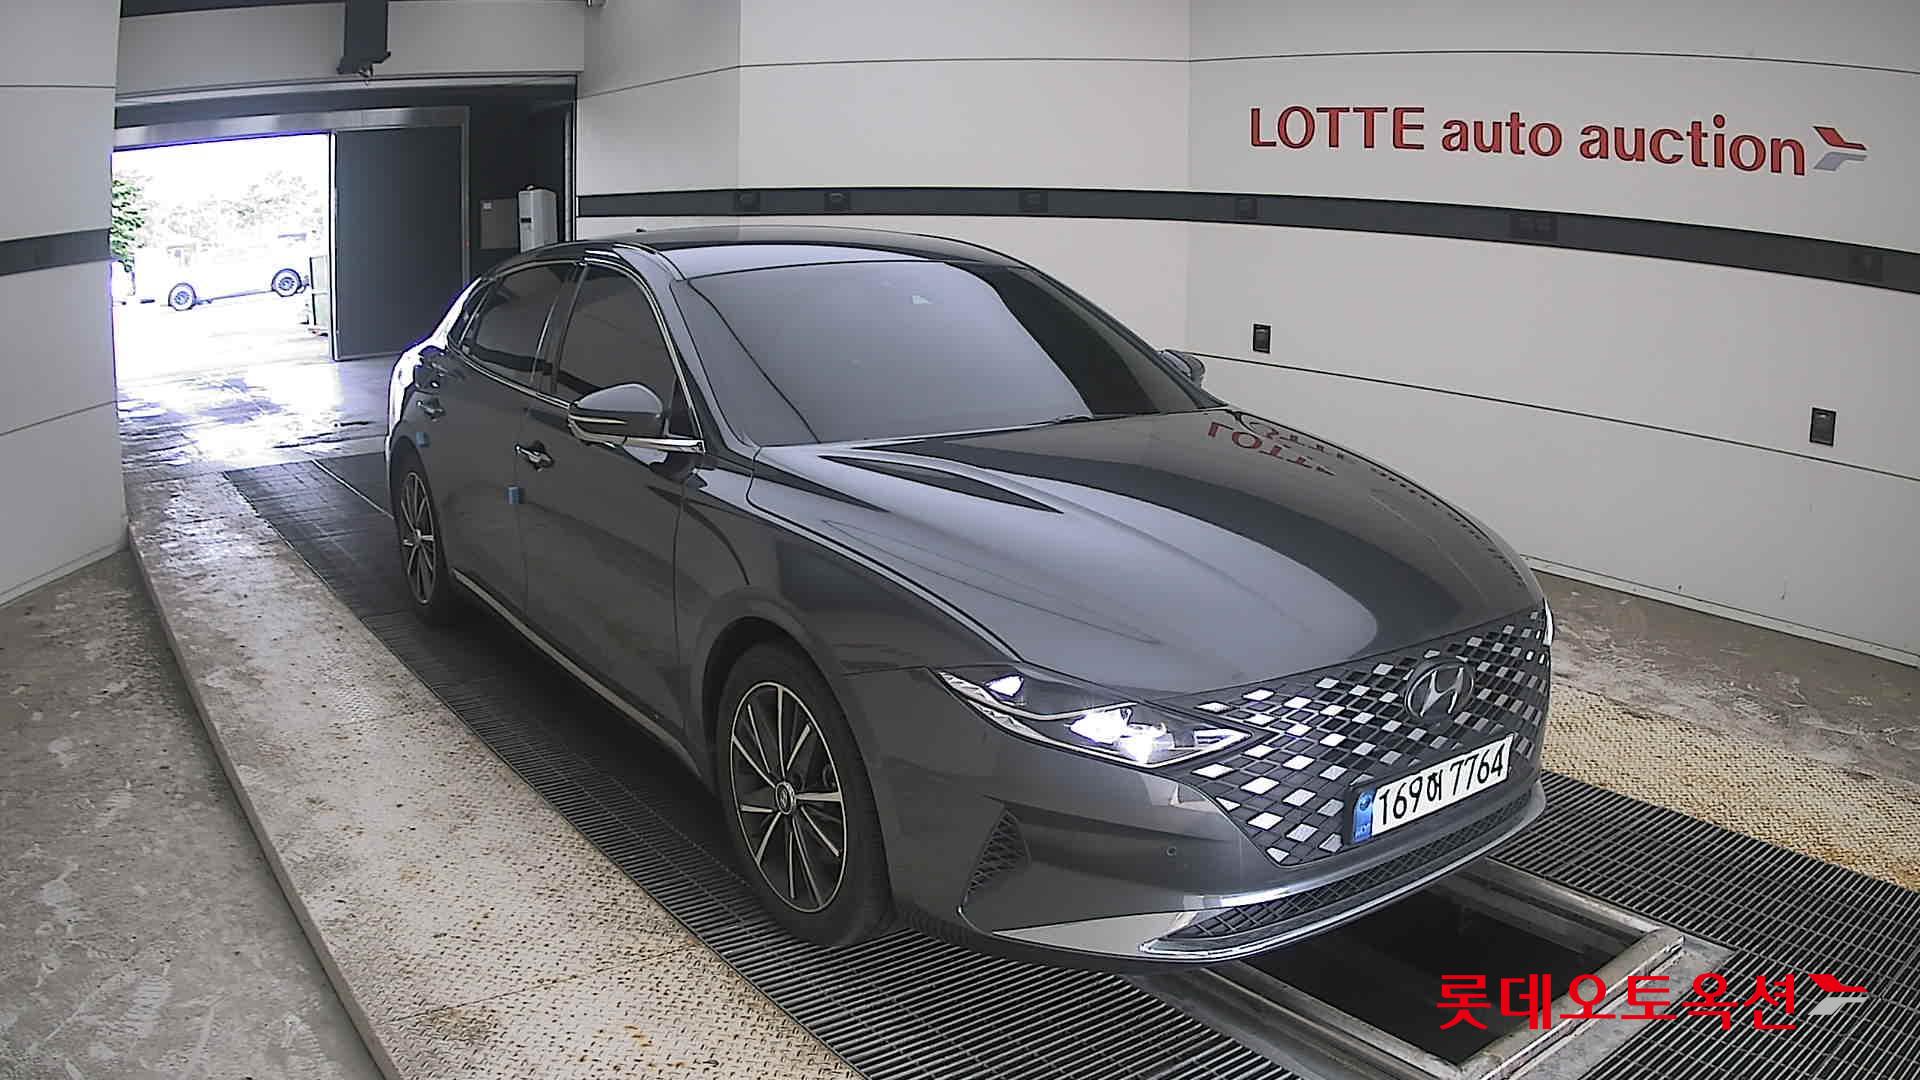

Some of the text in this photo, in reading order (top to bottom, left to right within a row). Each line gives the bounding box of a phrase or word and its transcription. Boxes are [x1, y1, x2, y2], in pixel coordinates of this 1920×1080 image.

[1250, 107, 1806, 176] LOTTE auto auction
[1379, 743, 1505, 825] 169허 7764
